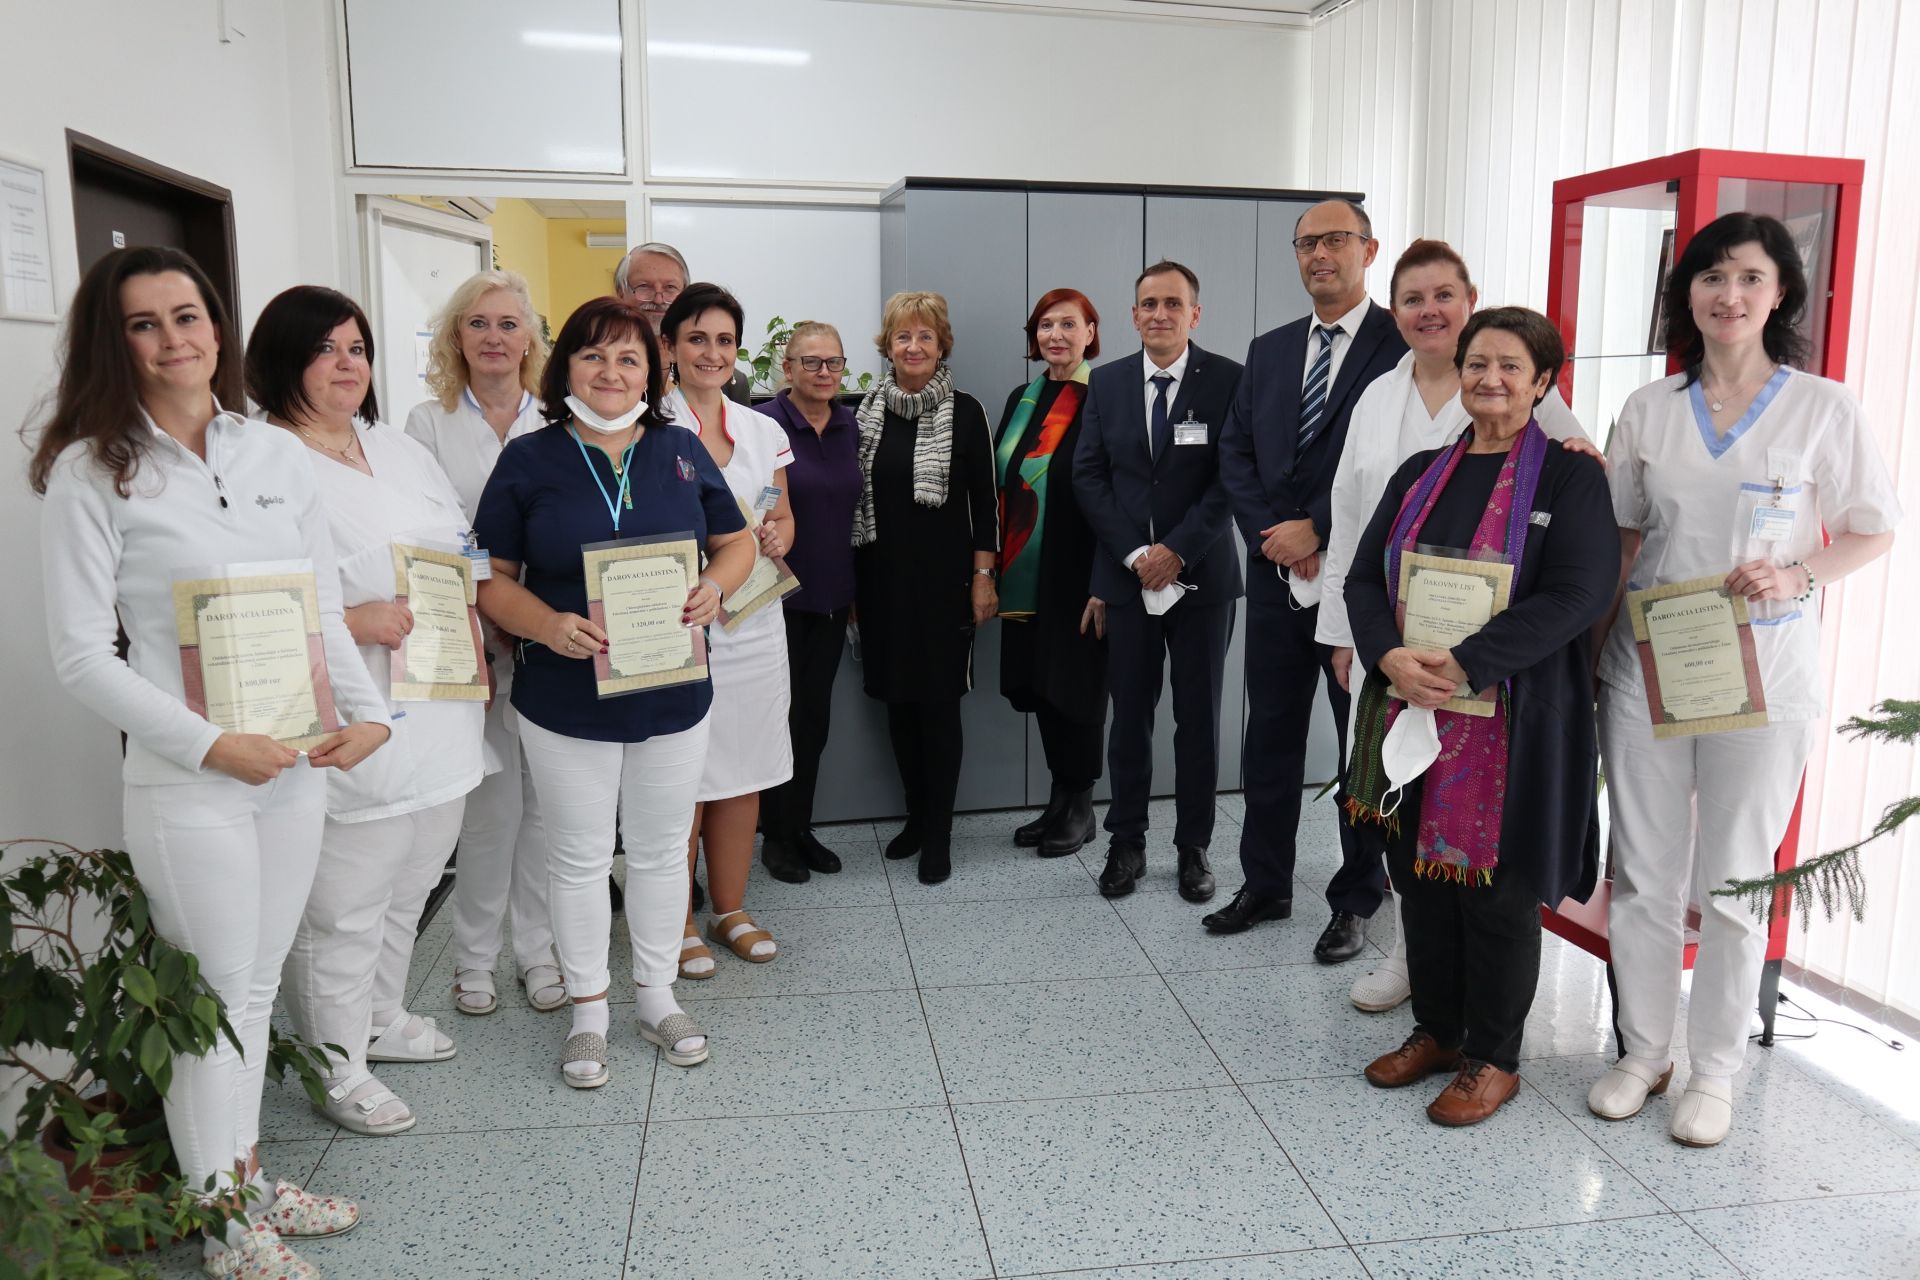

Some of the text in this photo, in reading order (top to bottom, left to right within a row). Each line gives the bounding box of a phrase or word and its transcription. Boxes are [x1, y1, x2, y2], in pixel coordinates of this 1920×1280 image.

[607, 568, 678, 582] DAROVACIA LISTINA
[1460, 583, 1475, 591] LIST
[206, 608, 295, 622] DAROVACIA LISTINA
[1652, 603, 1724, 622] DAROVACIA LISTINA
